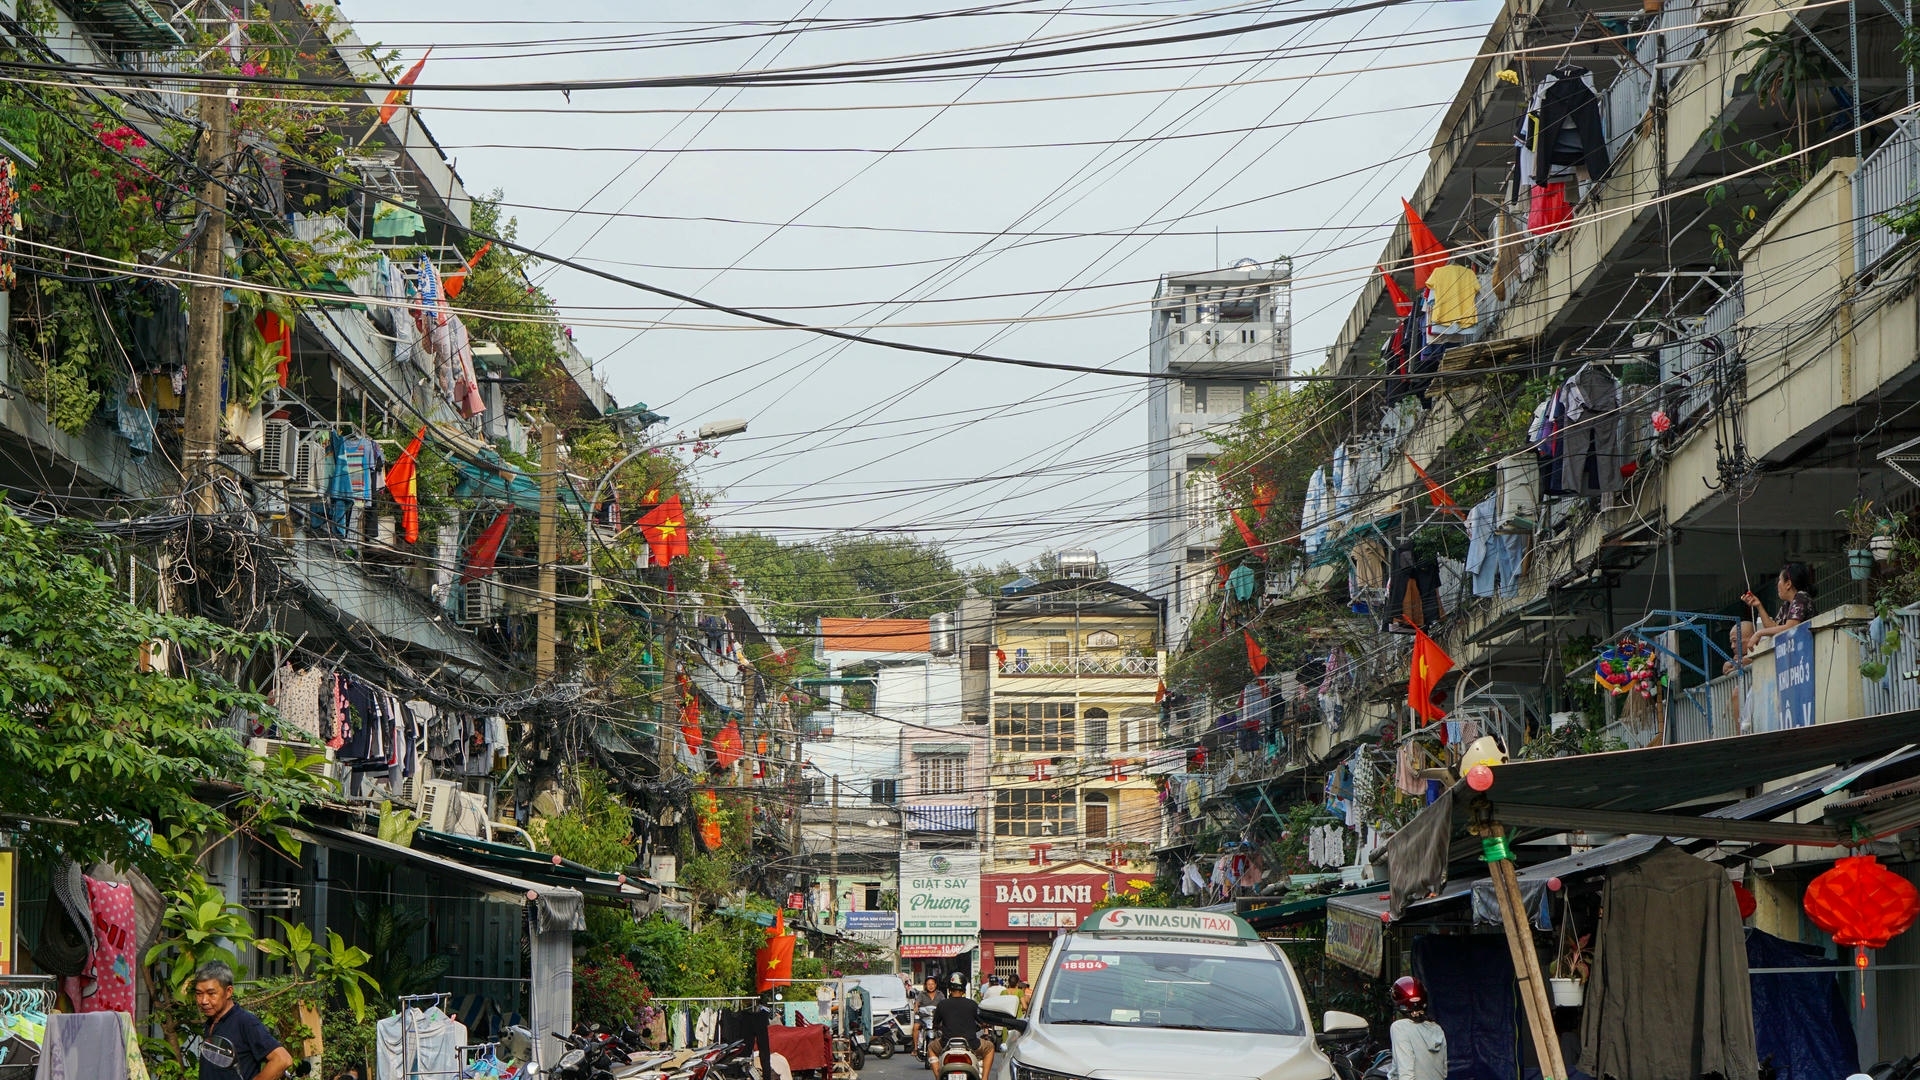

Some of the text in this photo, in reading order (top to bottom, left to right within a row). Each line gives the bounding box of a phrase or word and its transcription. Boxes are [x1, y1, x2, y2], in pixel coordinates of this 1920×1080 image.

[1779, 656, 1810, 690] KHU PHỐ 3
[995, 878, 1092, 903] BẢO LINH
[1134, 914, 1231, 932] VINASUN TAXI
[1064, 961, 1103, 969] 18804
